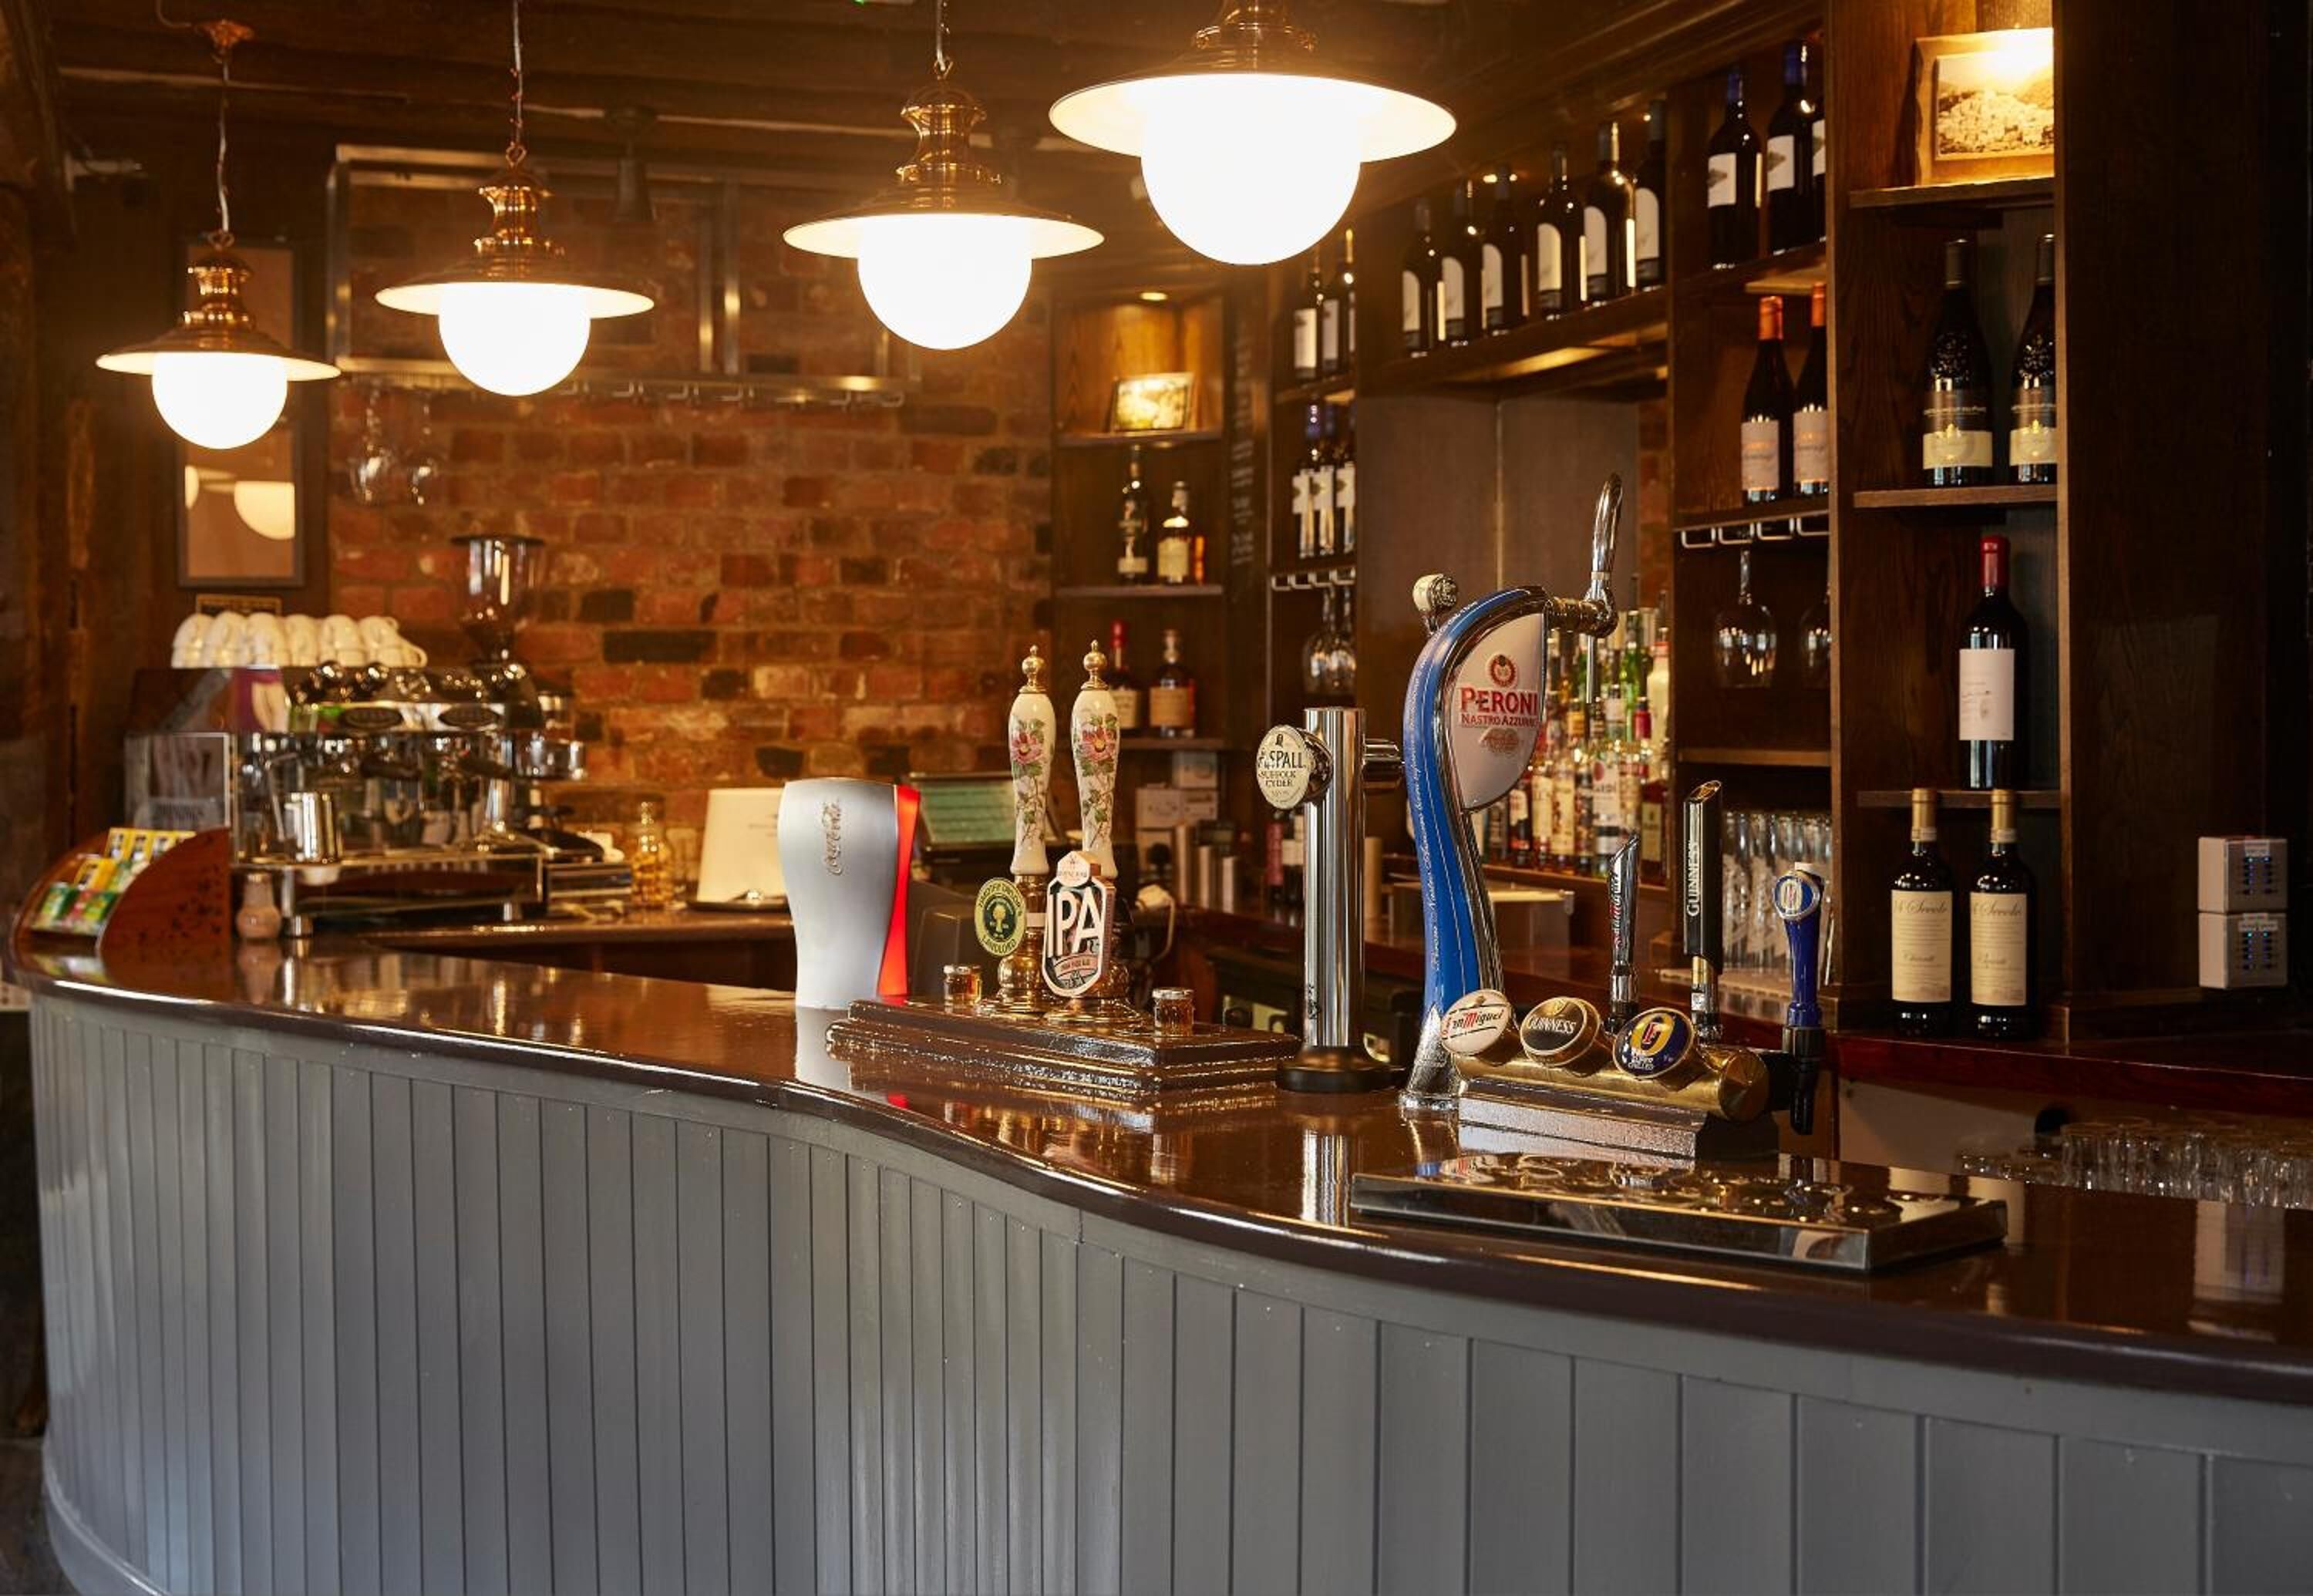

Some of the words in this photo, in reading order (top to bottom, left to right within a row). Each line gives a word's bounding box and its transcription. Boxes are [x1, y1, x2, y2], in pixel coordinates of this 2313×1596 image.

[1460, 687, 1539, 716] PERONI
[1461, 714, 1500, 726] NASTRO
[1502, 716, 1540, 727] AZZURRO
[1265, 779, 1293, 788] CYDER
[1686, 840, 1700, 917] GUINNESS
[1046, 887, 1101, 959] IPA
[1463, 1008, 1504, 1030] Miguel
[1527, 1015, 1577, 1035] GUINNESS
